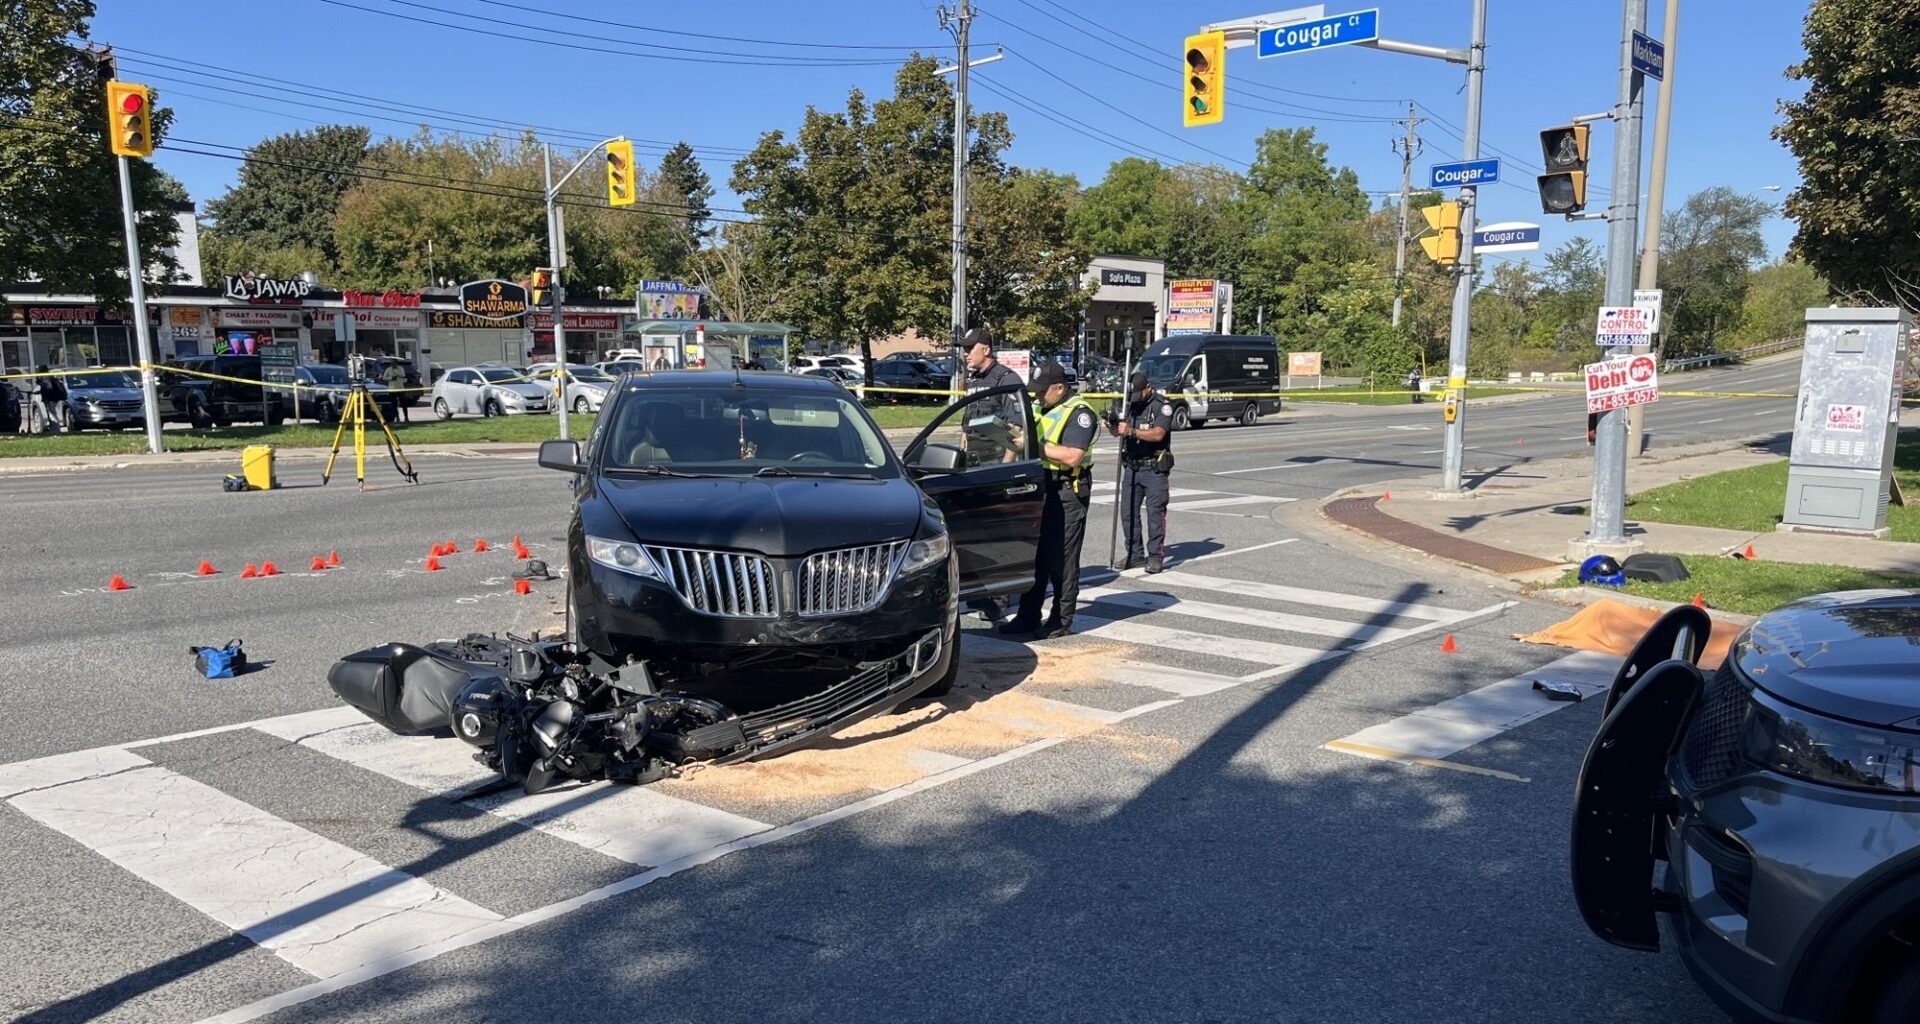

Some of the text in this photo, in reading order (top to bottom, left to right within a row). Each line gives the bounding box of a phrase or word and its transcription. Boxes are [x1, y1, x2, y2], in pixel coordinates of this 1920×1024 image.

[1274, 15, 1360, 48] Cougar Ct
[1633, 39, 1663, 69] Markham
[1435, 168, 1483, 183] Cougar
[1483, 231, 1526, 243] Cougar Ct
[1109, 272, 1142, 285] Safa Plaza
[224, 275, 310, 300] LA JAWAB
[645, 281, 677, 292] JAFFNA
[466, 300, 525, 312] SHAWARMA
[1180, 307, 1211, 315] PHARMACY
[29, 308, 98, 320] SWEET
[1617, 309, 1642, 320] PEST
[447, 314, 519, 328] SHAWARMA
[564, 317, 616, 328] OIN LAUNDRY
[1600, 320, 1649, 330] CONTROL
[172, 327, 199, 337] 262
[1586, 365, 1603, 374] Cut
[1605, 361, 1627, 370] Your
[1631, 365, 1653, 379] 80%
[1588, 370, 1628, 392] Debt
[1589, 390, 1657, 412] 647-853-0573
